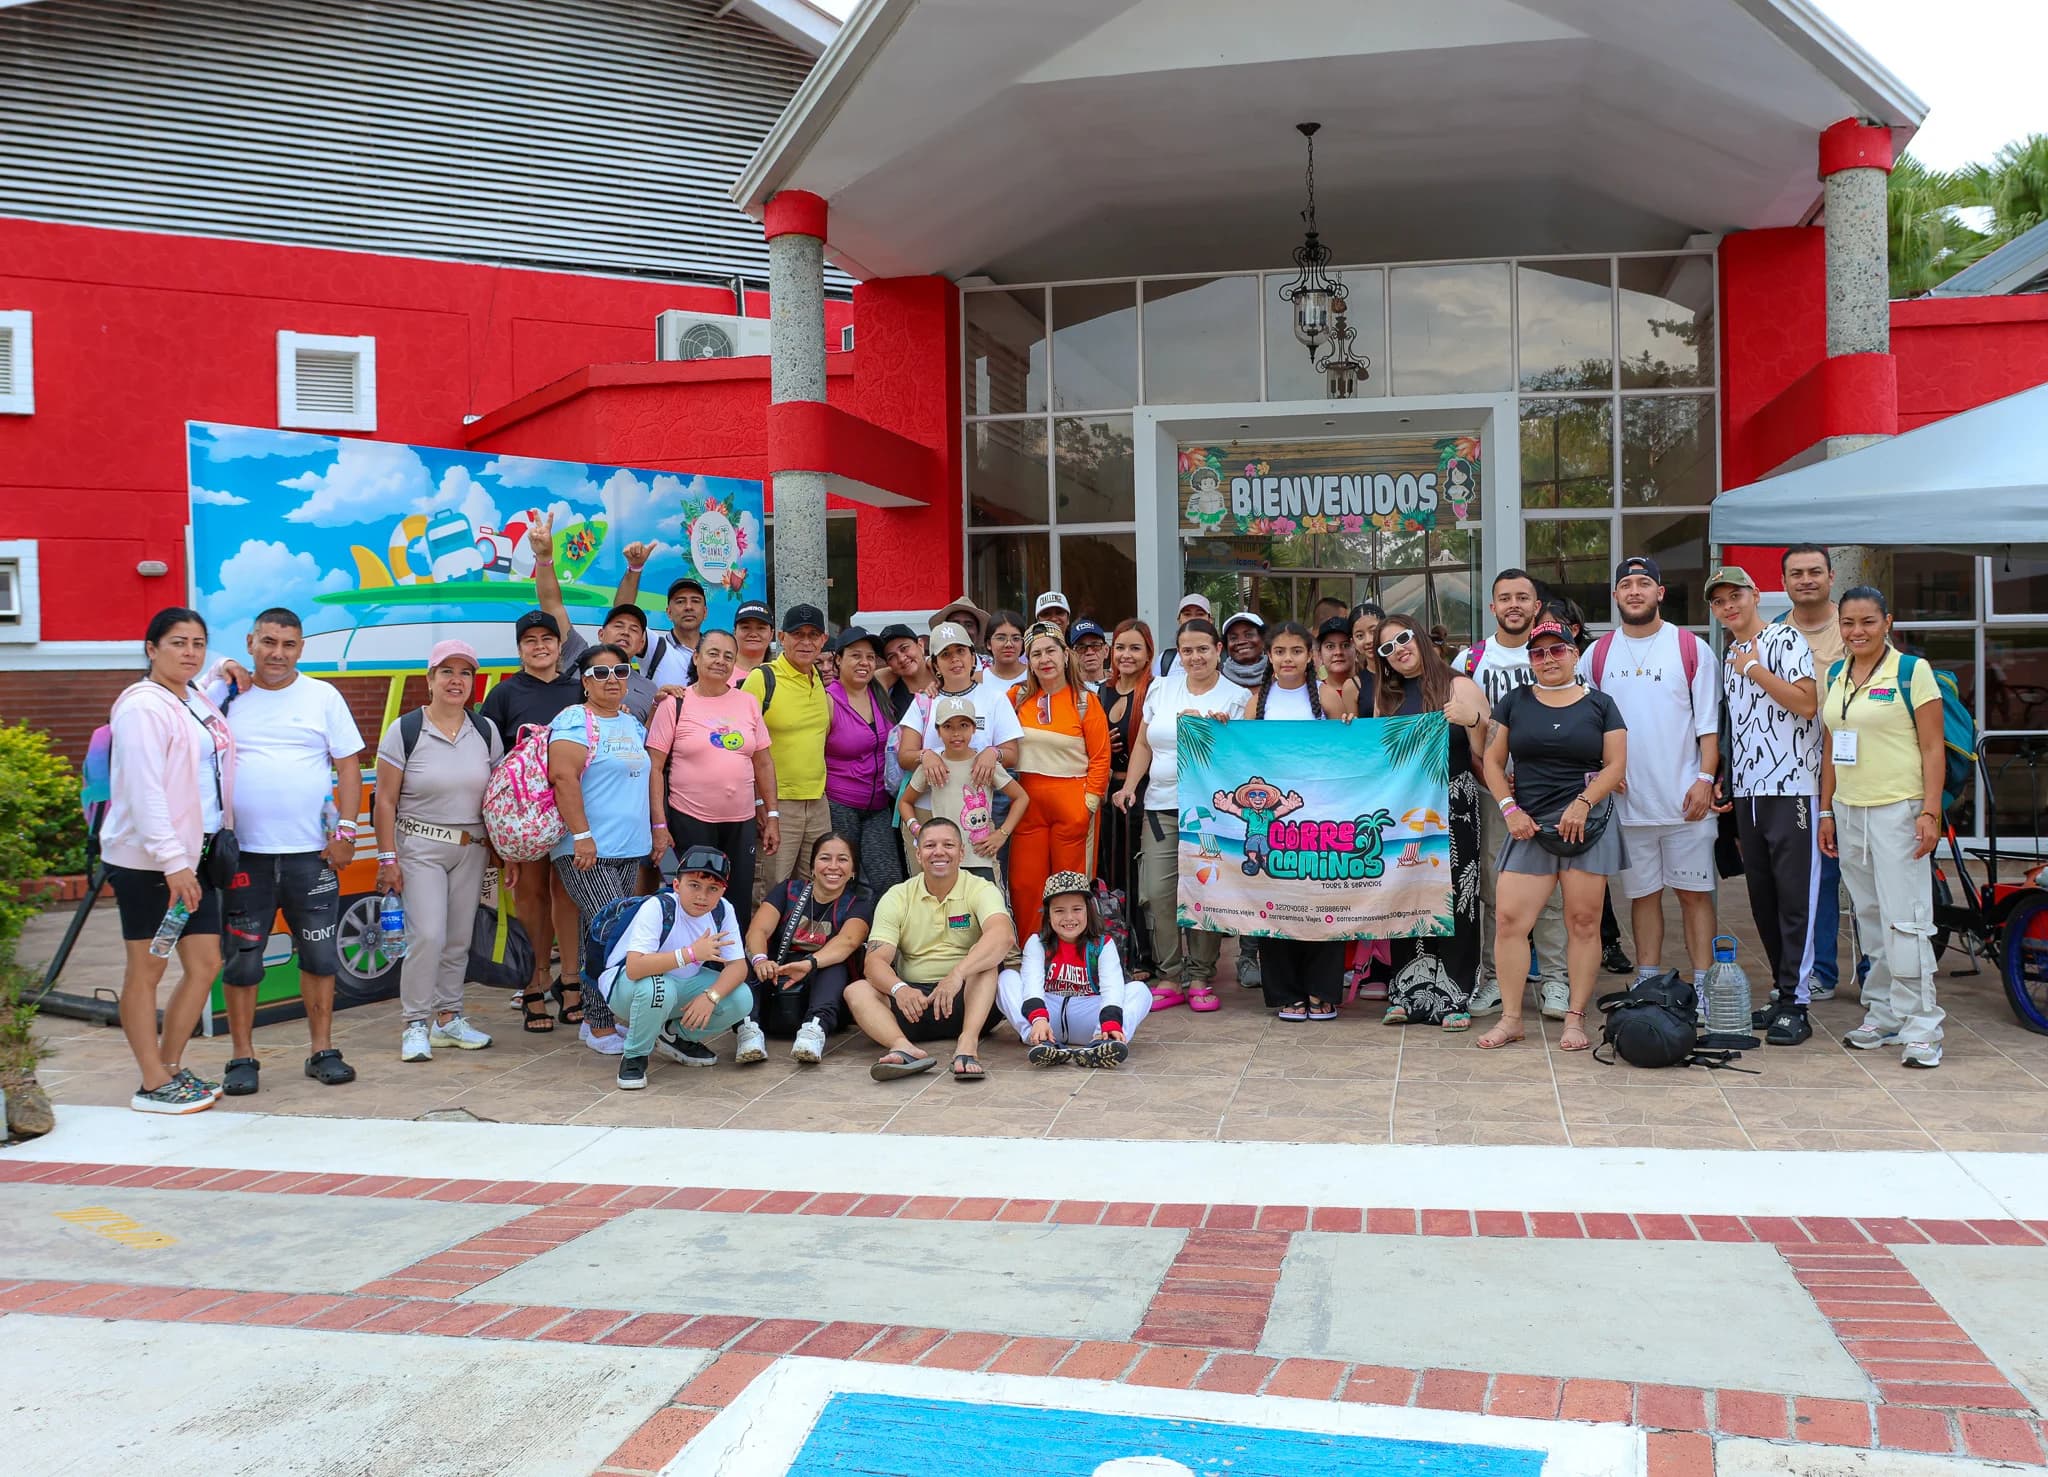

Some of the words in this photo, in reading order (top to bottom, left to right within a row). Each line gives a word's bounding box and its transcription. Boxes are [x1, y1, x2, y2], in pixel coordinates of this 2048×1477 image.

[1231, 473, 1438, 516] BIENVENIDOS
[1608, 668, 1662, 680] AMRI
[1343, 881, 1349, 889] &
[302, 923, 336, 942] DON'T
